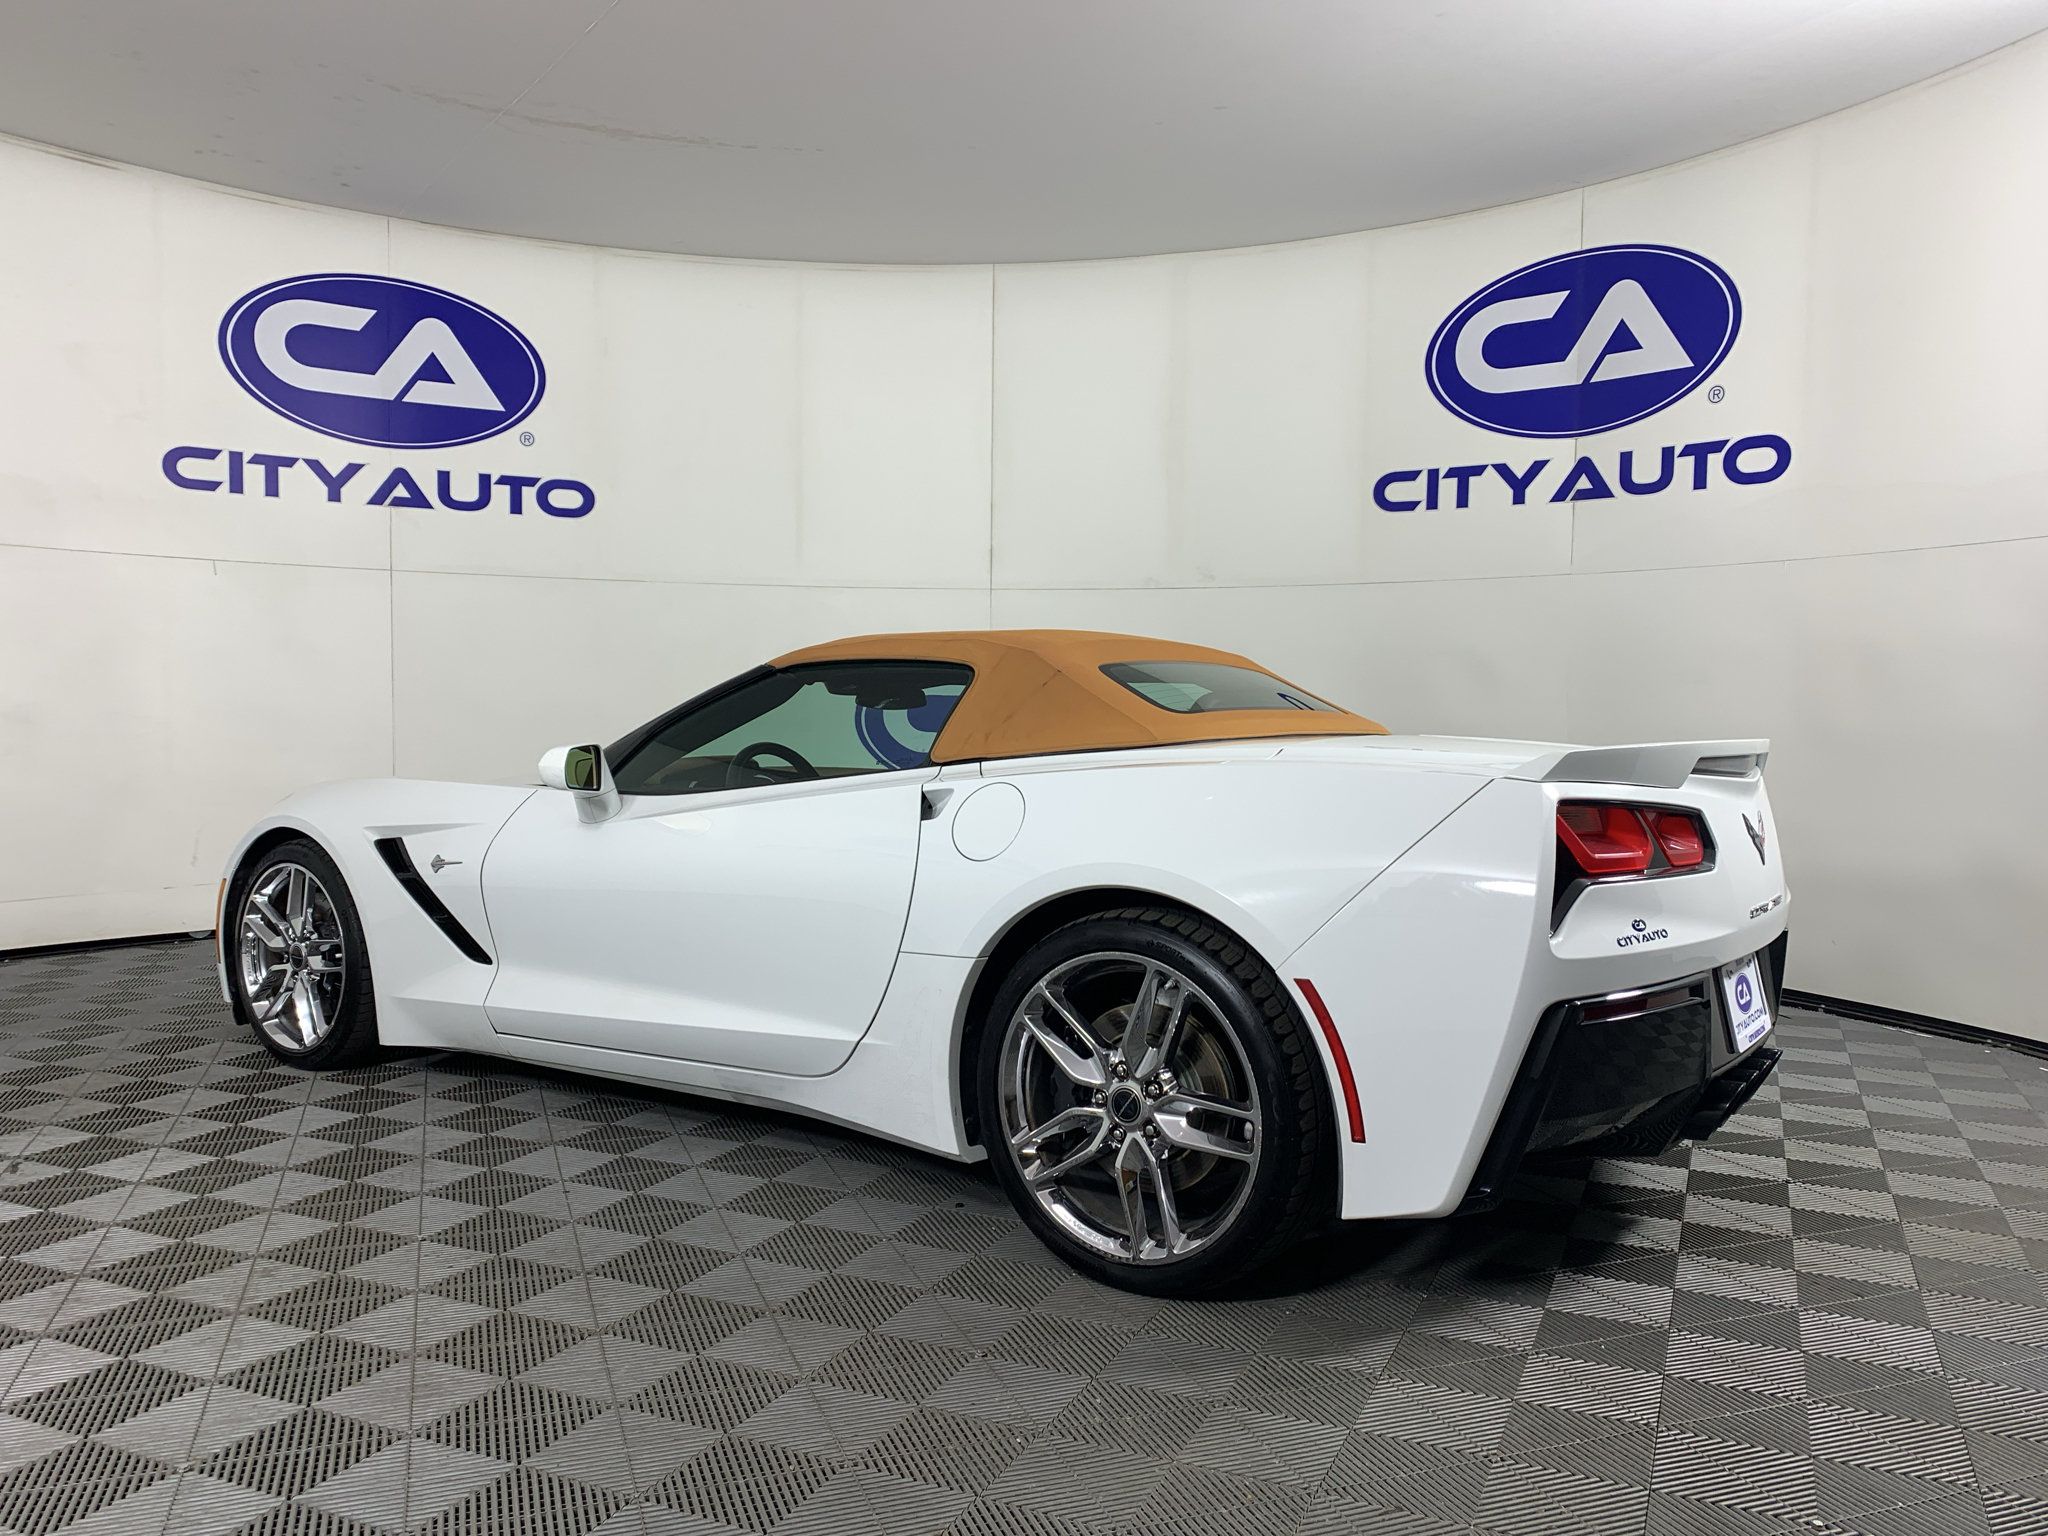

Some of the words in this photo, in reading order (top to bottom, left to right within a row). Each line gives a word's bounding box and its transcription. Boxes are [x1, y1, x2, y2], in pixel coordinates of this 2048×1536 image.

[254, 299, 506, 412] CA
[1455, 279, 1694, 394] CA
[162, 445, 367, 503] CITY
[366, 467, 596, 518] AUTO
[1373, 459, 1551, 512] CITY
[1549, 434, 1792, 503] AUTO
[1616, 934, 1641, 947] CITY
[1642, 928, 1669, 943] AUTO
[1737, 983, 1751, 1005] CA
